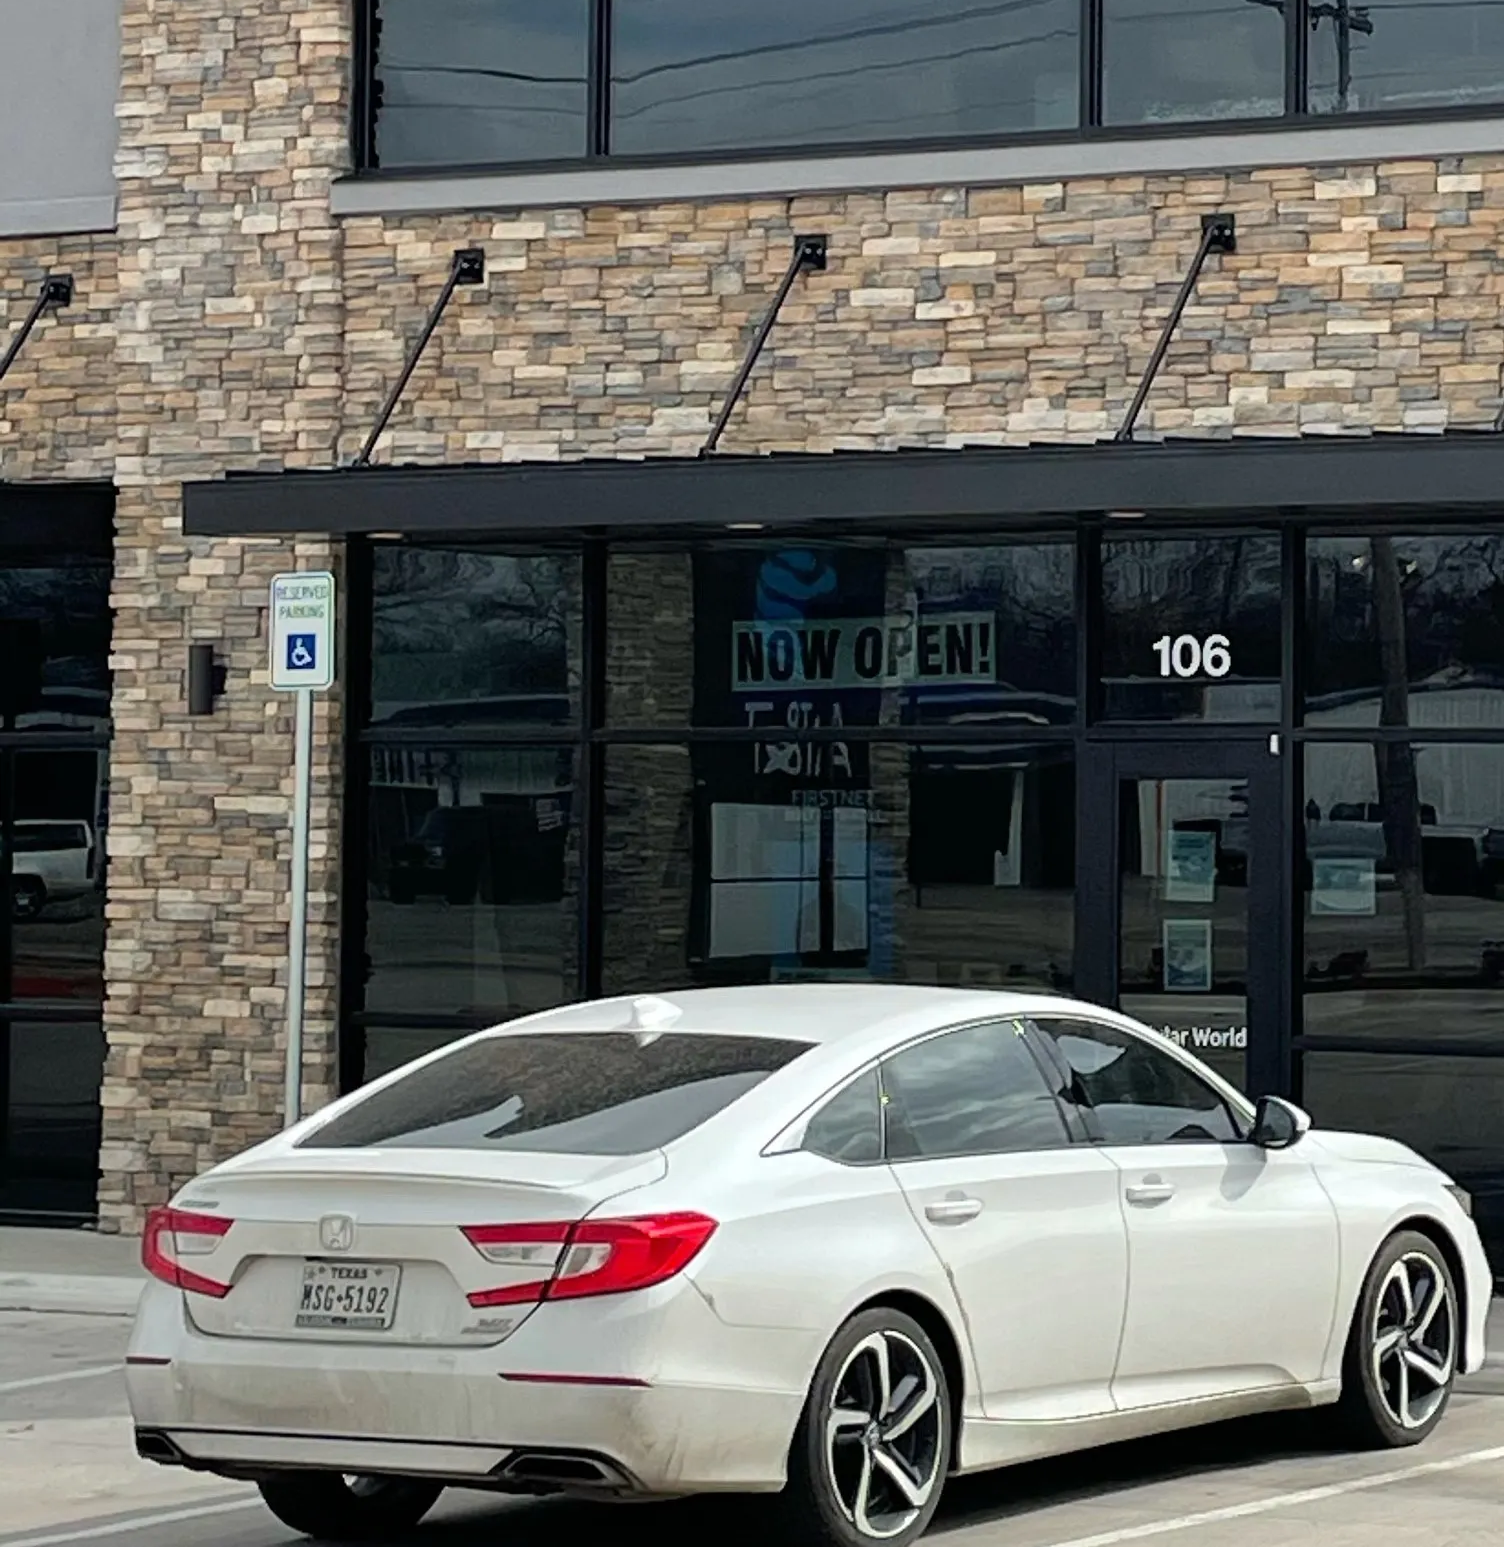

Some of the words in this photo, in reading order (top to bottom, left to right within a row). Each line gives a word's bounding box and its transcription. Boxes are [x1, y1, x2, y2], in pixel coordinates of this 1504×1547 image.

[736, 628, 842, 682] NOW
[853, 622, 992, 679] OPEN!
[1152, 634, 1231, 677] 106
[1191, 1026, 1248, 1047] World
[332, 1266, 368, 1279] TEXAS
